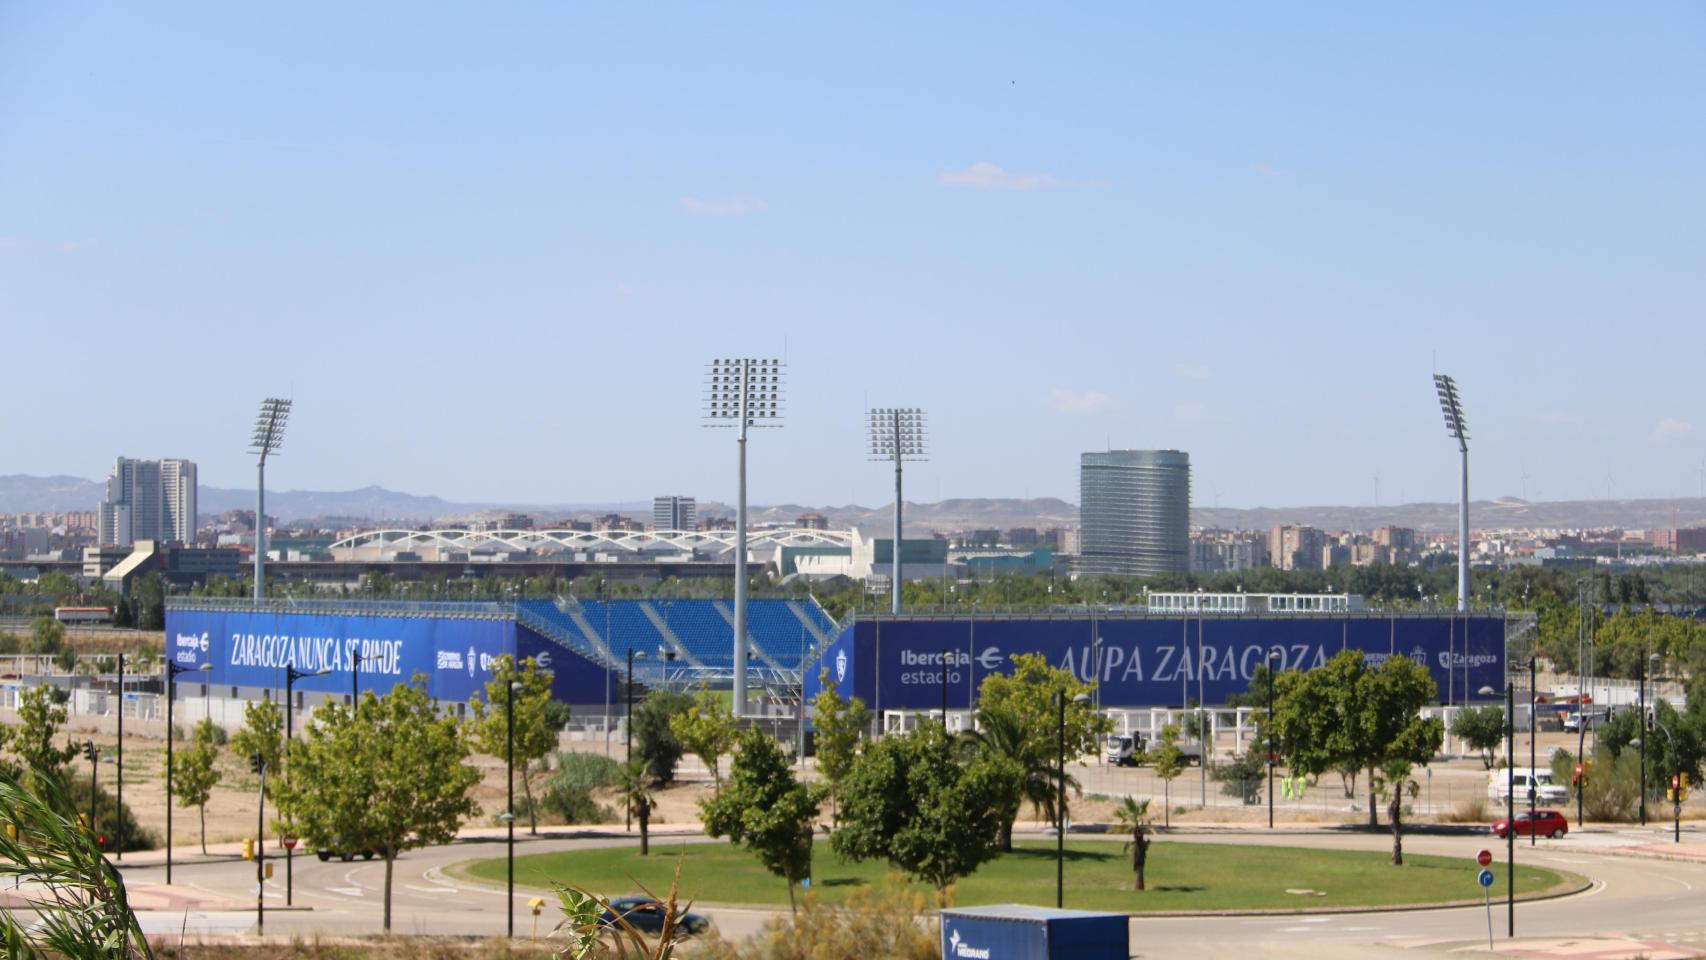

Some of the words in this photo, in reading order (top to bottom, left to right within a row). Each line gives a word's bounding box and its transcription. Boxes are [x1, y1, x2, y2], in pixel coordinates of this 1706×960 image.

[231, 633, 297, 669] ZARAGOZA
[298, 637, 341, 671] NUNCA
[361, 639, 403, 675] RINDE
[901, 649, 970, 668] Ibercaja
[1060, 637, 1143, 682] AÚPA
[1151, 644, 1327, 682] ZARAGOZA
